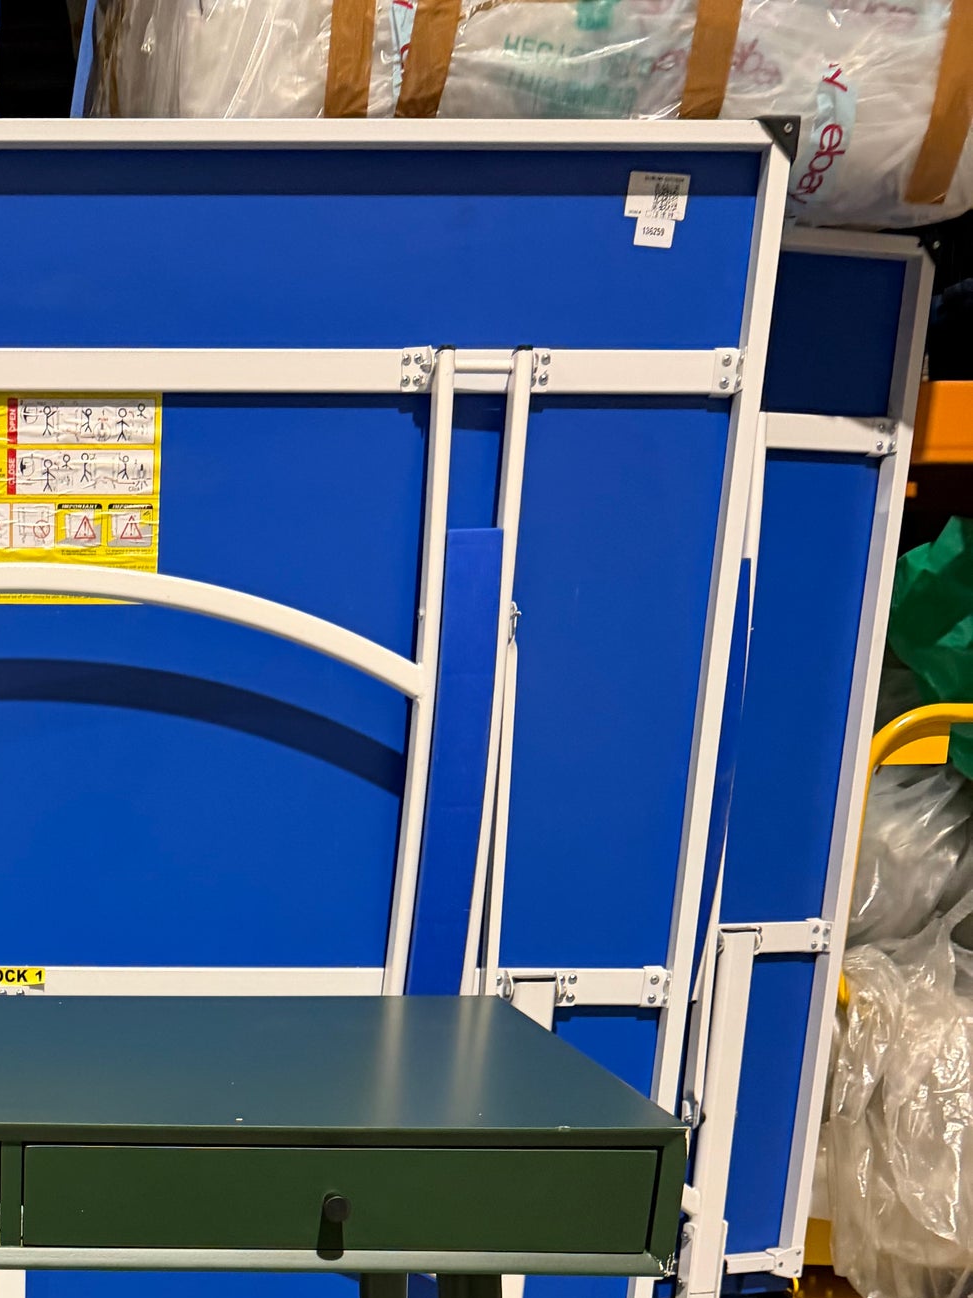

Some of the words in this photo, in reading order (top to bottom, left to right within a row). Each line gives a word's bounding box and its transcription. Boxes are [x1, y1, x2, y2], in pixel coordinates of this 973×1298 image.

[790, 123, 846, 204] ebay
[8, 457, 16, 486] CLOSE
[35, 970, 42, 982] 1
